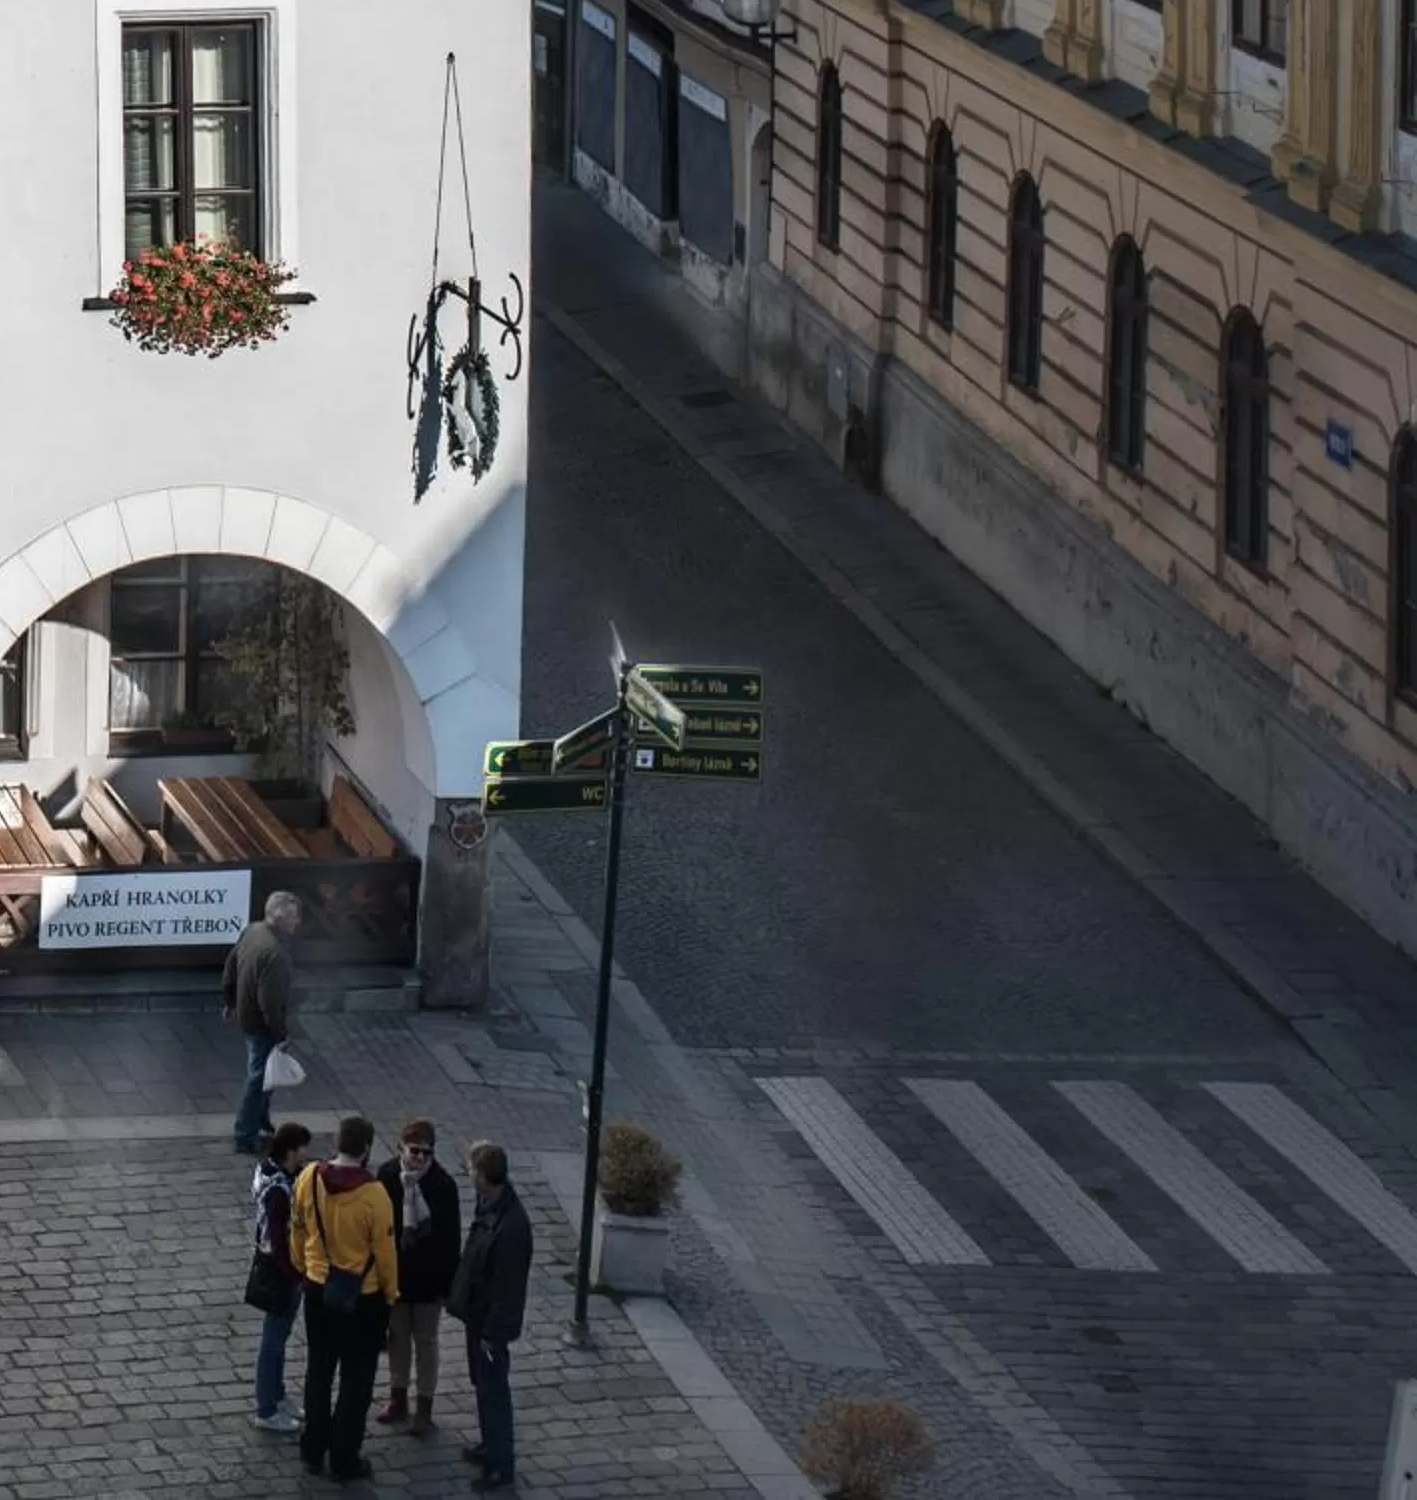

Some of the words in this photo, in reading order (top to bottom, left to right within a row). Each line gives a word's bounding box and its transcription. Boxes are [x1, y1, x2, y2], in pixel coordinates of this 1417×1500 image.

[582, 786, 603, 800] WC
[66, 889, 121, 909] KAPŘÍ
[127, 889, 228, 906] HRANOLKY
[47, 923, 90, 938] PIVO
[94, 919, 167, 937] REGENT
[171, 915, 241, 935] TŘEBOŇ
